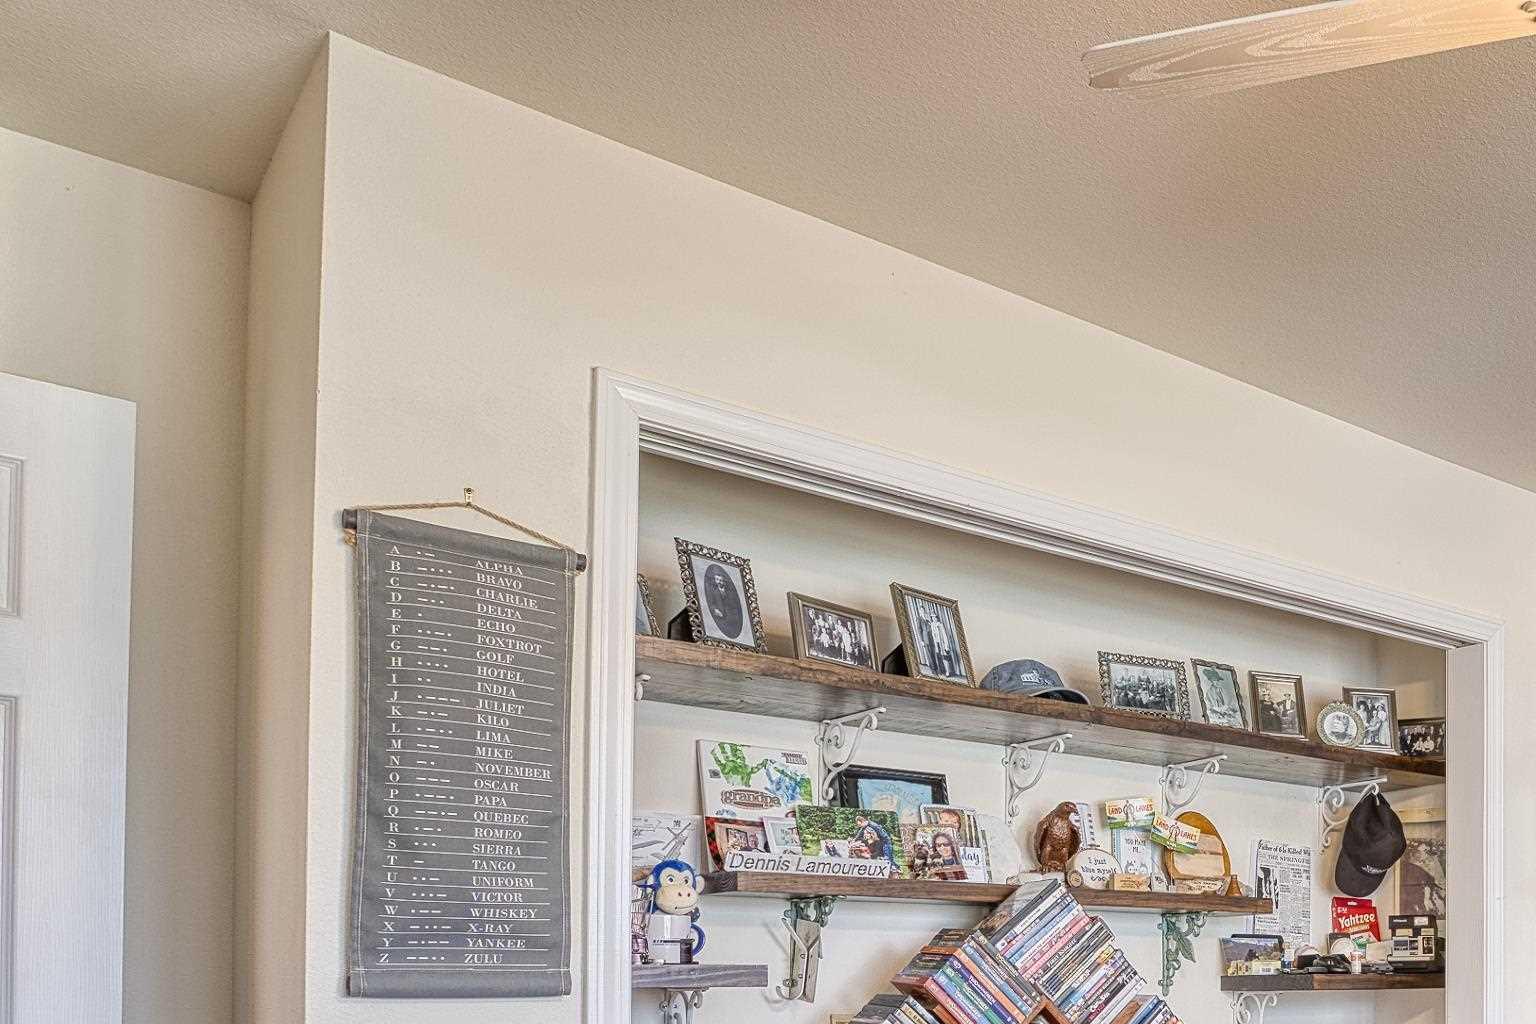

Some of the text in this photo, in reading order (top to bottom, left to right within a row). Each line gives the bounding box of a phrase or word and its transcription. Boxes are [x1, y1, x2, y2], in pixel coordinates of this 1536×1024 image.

[391, 546, 523, 575] A ALPHA
[391, 561, 521, 590] B BRAVO
[391, 578, 537, 608] C CHARLIE
[391, 592, 521, 619] D DELTA
[392, 609, 515, 633] E ECHO
[392, 625, 542, 653] F FOXTROT
[391, 641, 514, 663] G GOLF
[392, 657, 524, 682] H HOTEL
[392, 674, 516, 697] I INDIA
[391, 691, 524, 715] J JULIET
[392, 706, 509, 727] K KILO
[392, 723, 510, 743] L LIMA
[391, 739, 513, 759] M MIKE
[390, 756, 551, 779] N NOVEMBER
[390, 772, 519, 792] O OSCAR
[390, 789, 507, 806] P PAPA
[721, 789, 781, 809] grandpa
[388, 805, 529, 824] Q QUEBEC
[1109, 803, 1153, 815] LAND LAKES
[389, 823, 522, 839] R ROMEO
[1156, 819, 1169, 830] LAND
[389, 839, 521, 855] S SIERRA
[387, 856, 516, 871] T TANGO
[729, 854, 888, 877] Dennis Lamoureux
[387, 873, 534, 887] U UNIFORM
[386, 889, 523, 902] V VICTOR
[385, 906, 537, 918] W WHISKEY
[1338, 913, 1376, 928] Yahtzee
[384, 922, 513, 933] X X-RAY
[383, 938, 525, 948] Y YANKEE
[380, 954, 502, 963] Z ZULU
